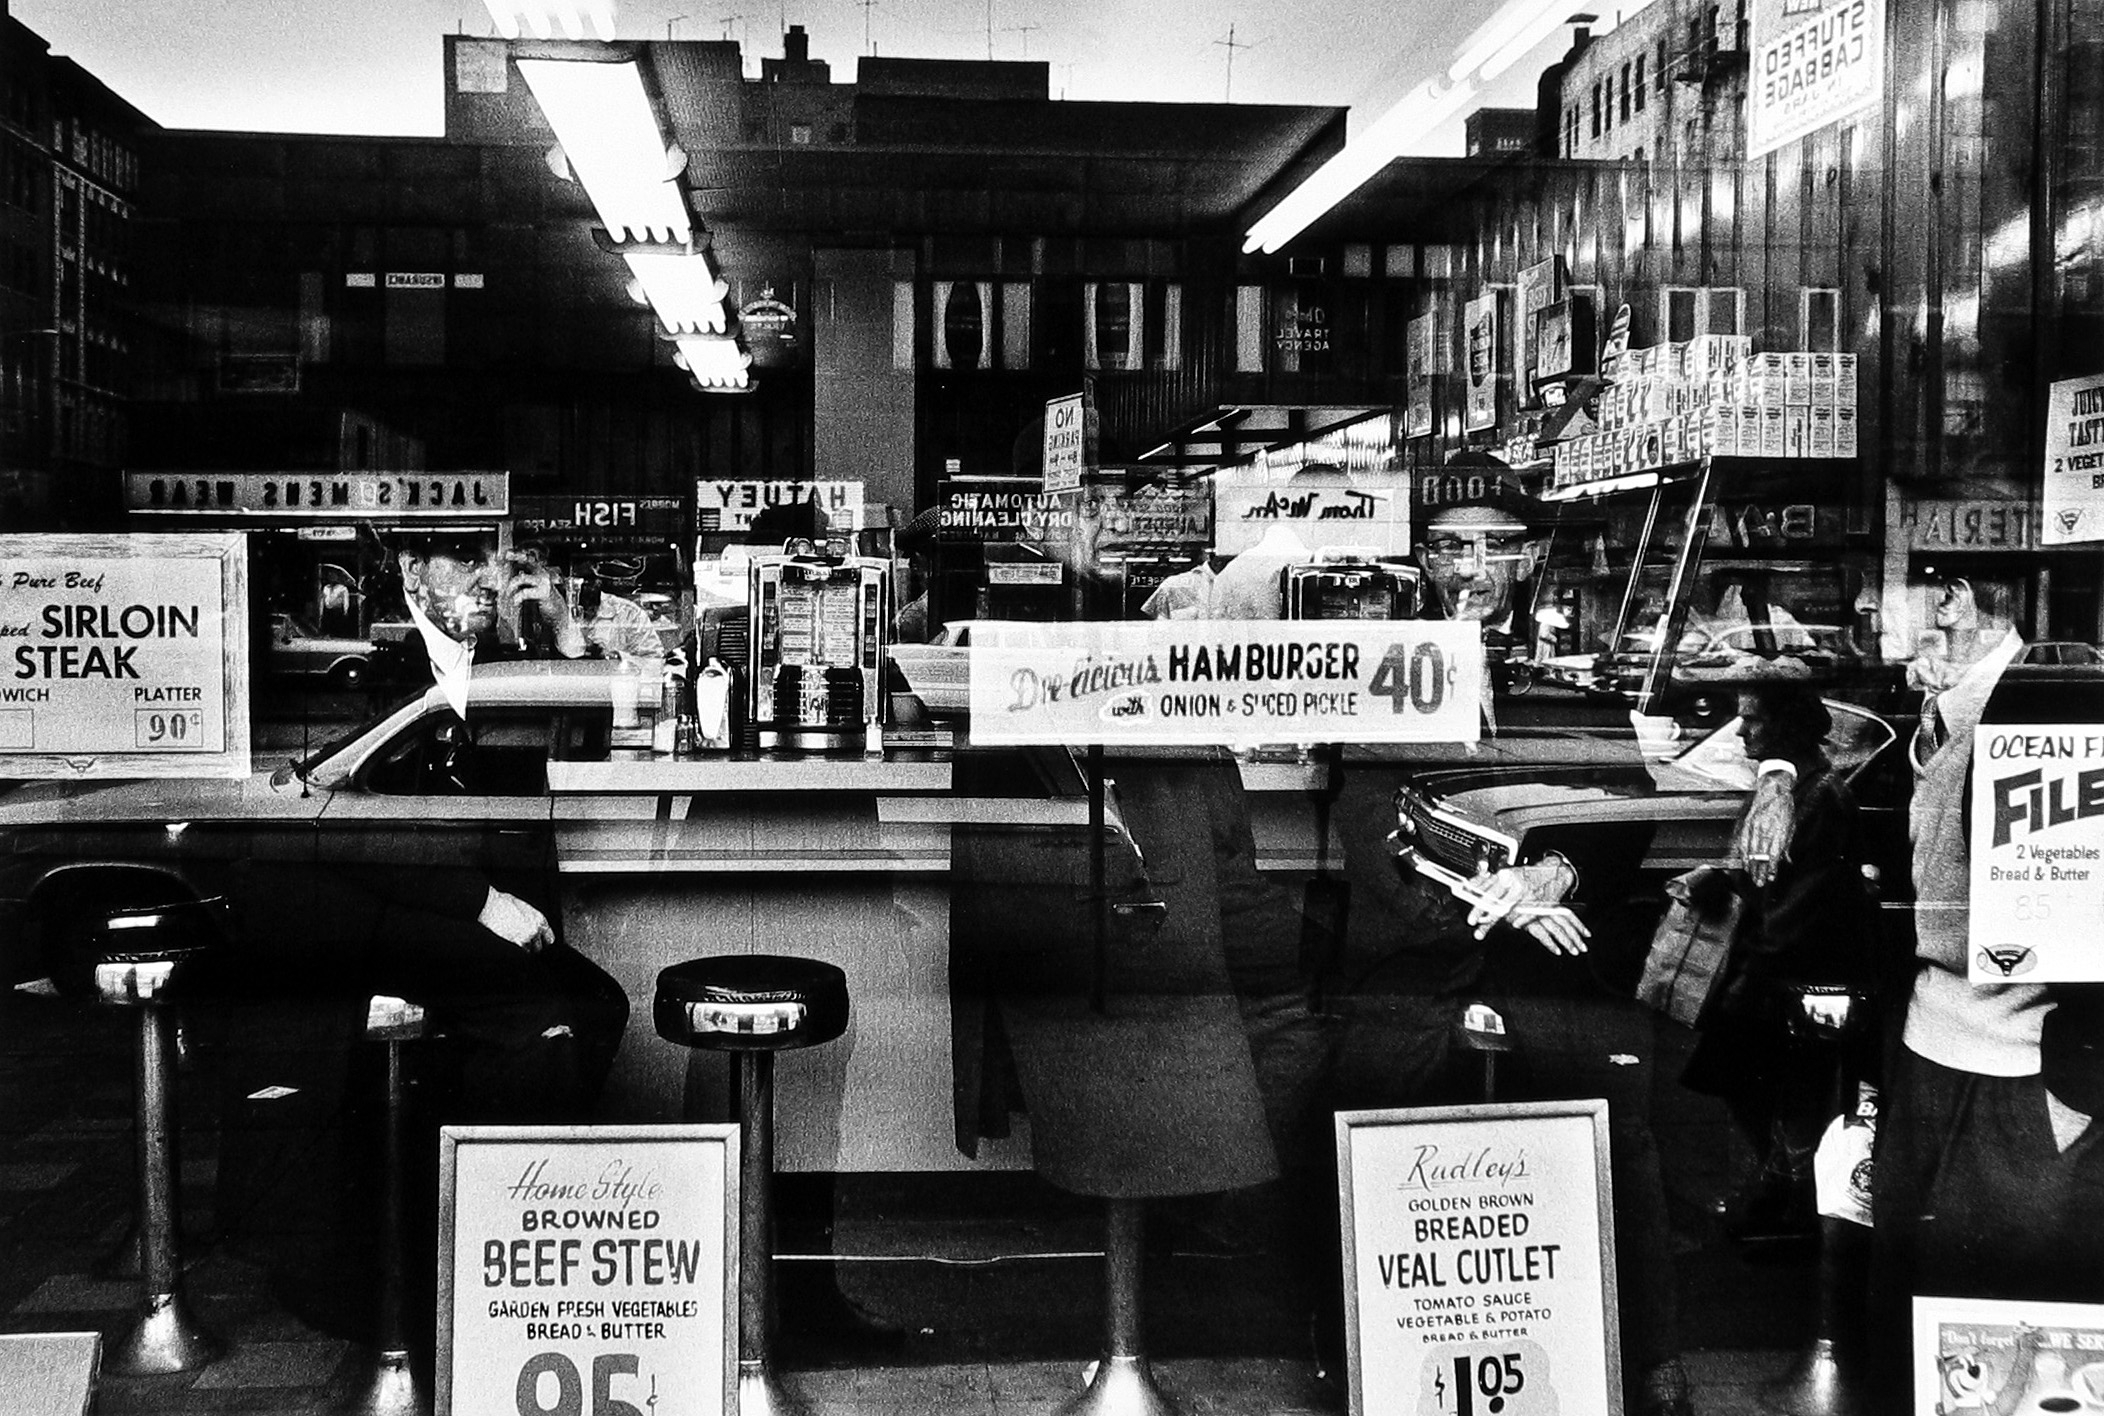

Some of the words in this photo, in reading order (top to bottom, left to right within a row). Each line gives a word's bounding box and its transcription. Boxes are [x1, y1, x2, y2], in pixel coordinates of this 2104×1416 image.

[2054, 459, 2064, 473] 2
[12, 572, 57, 590] Pure
[64, 571, 105, 593] Beef
[41, 604, 199, 639] SIRLOIN
[15, 646, 141, 679] STEAK
[1169, 641, 1360, 682] HAMBURGER
[0, 688, 50, 701] WICH
[134, 687, 202, 701] PLATTER
[1160, 694, 1221, 718] ONION
[1226, 698, 1237, 713] &
[1303, 692, 1360, 716] PICKLE
[1989, 734, 2075, 760] OCEAN
[2016, 844, 2026, 860] 2
[2029, 844, 2100, 864] Vegetables
[1990, 867, 2030, 881] Bread
[2034, 867, 2046, 880] &
[2051, 867, 2090, 881] Butter
[1406, 1144, 1531, 1192] Rudley's
[507, 1158, 588, 1202] Home
[591, 1158, 664, 1209] Style
[1408, 1197, 1472, 1213] GOLDEN
[1479, 1193, 1535, 1209] BROWN
[522, 1209, 661, 1232] BROWNED
[1413, 1213, 1530, 1243] BREADED
[483, 1239, 583, 1287] BEEF
[591, 1238, 701, 1286] STEW
[1378, 1252, 1447, 1290] VEAL
[1456, 1244, 1561, 1285] CUTLET
[488, 1300, 551, 1319] GARDEN
[556, 1300, 605, 1318] FRESH
[611, 1300, 698, 1318] VEGETABLES
[1413, 1296, 1476, 1312] TOMATO
[1482, 1292, 1532, 1308] SAUCE
[1396, 1312, 1480, 1330] VEGETABLE
[1485, 1312, 1497, 1324] &
[1500, 1308, 1552, 1323] POTATO
[526, 1323, 583, 1340] BREAD
[601, 1323, 667, 1340] BUTTER
[1422, 1331, 1465, 1344] BREAD
[1470, 1330, 1479, 1341] &
[1482, 1327, 1529, 1340] BUTTER
